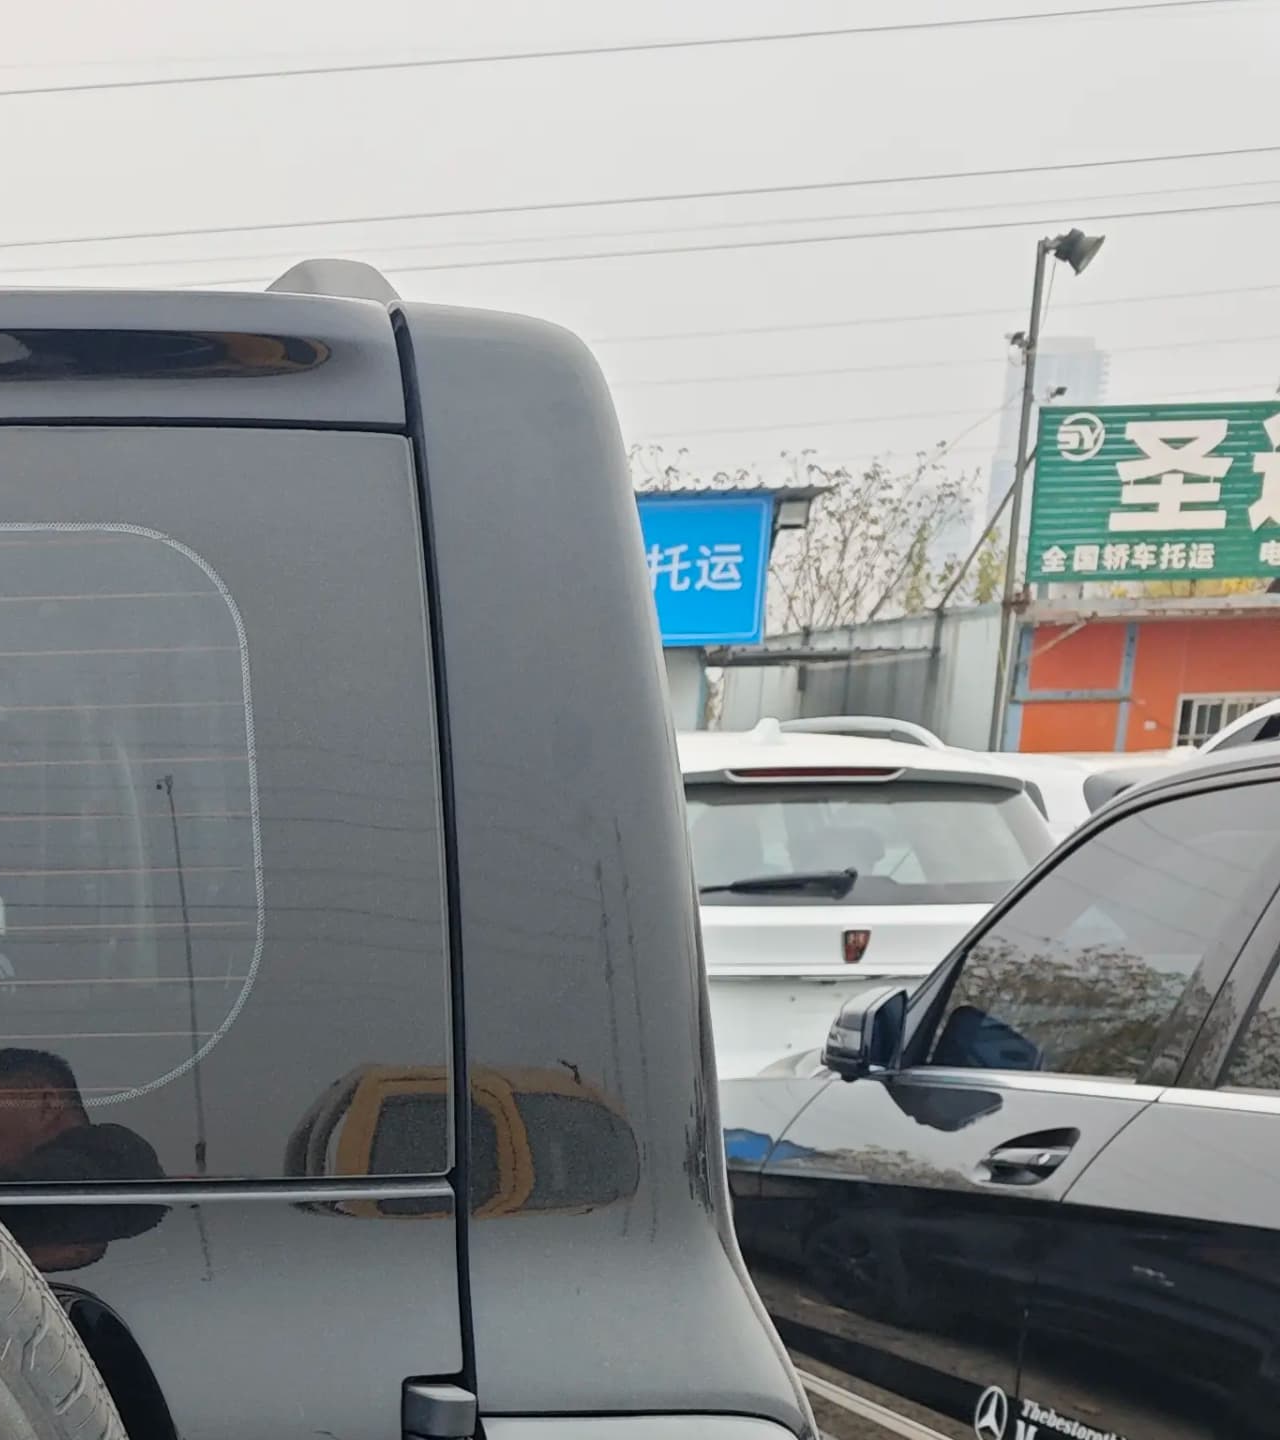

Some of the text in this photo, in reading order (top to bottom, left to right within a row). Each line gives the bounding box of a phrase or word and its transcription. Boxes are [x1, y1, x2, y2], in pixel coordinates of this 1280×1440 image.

[1108, 415, 1280, 532] 圣
[646, 543, 744, 592] 托运
[1041, 542, 1216, 573] 全国轿车托运
